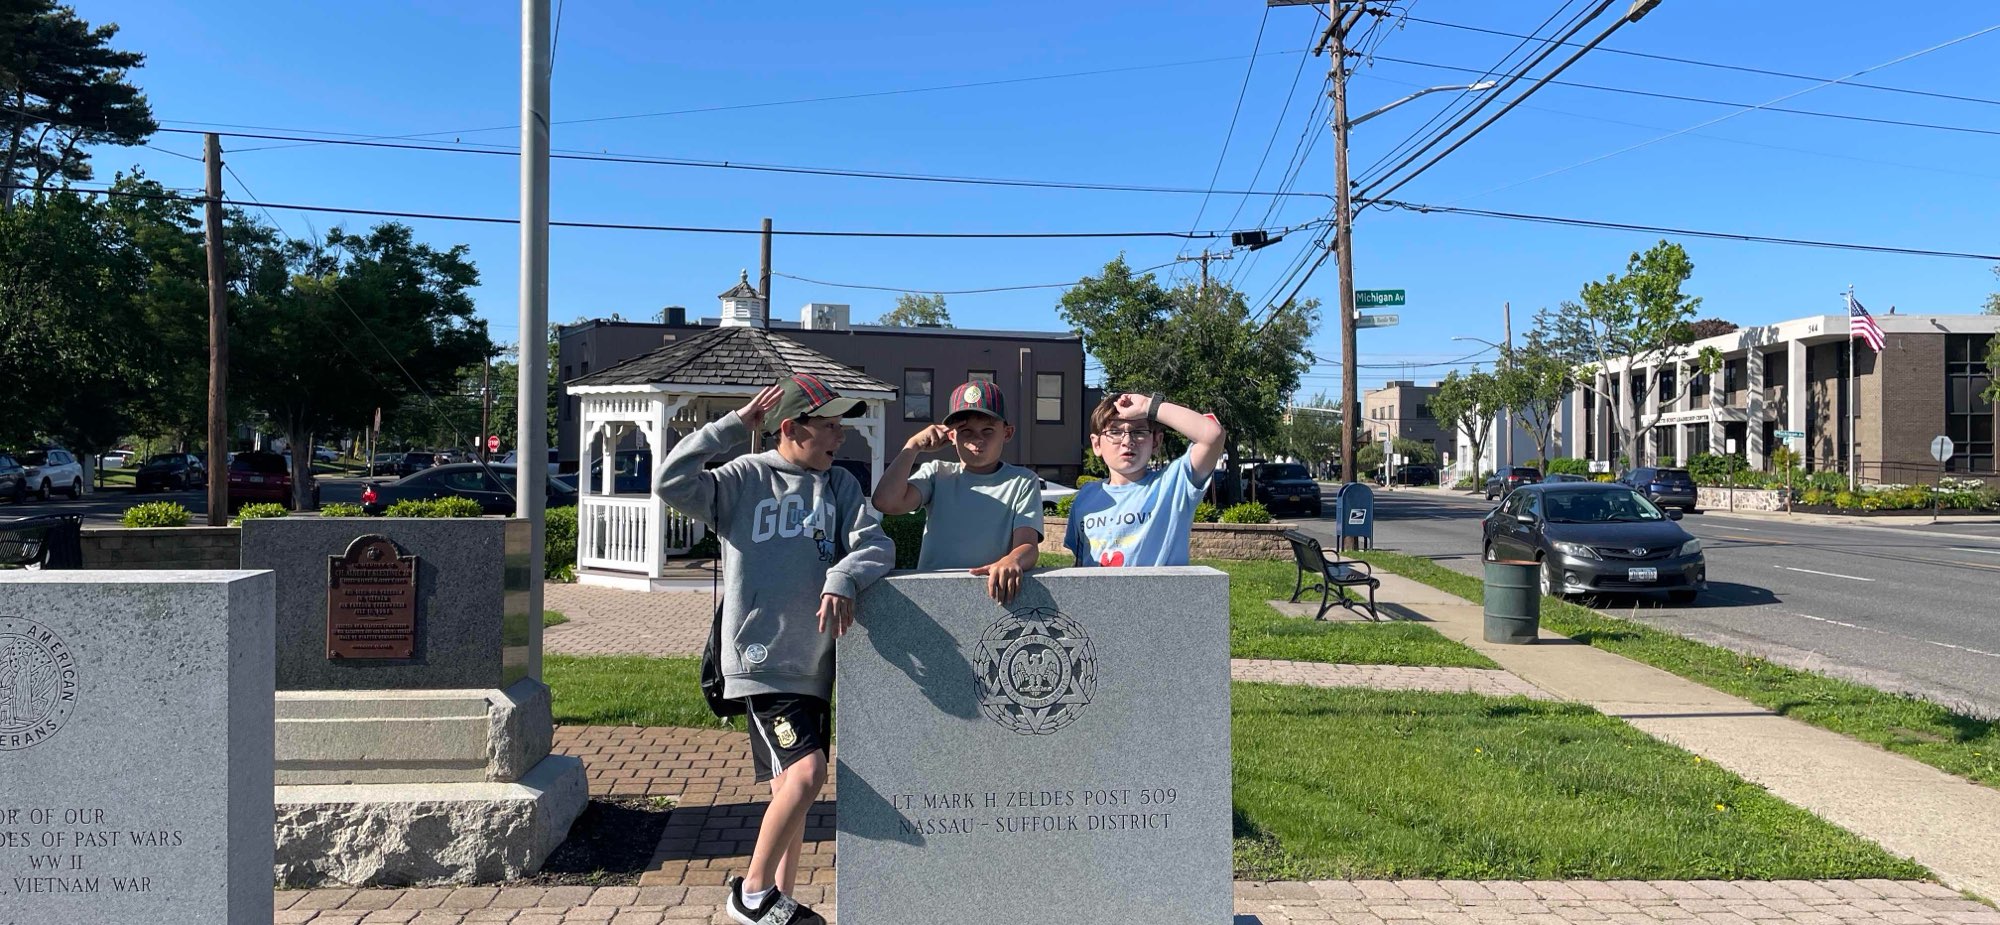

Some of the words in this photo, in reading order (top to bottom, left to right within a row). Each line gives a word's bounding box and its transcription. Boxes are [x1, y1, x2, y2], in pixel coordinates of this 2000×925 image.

[1356, 292, 1393, 304] Michigan
[1395, 293, 1404, 301] Av
[1023, 636, 1039, 644] WAR
[27, 625, 75, 701] AMERICAN
[0, 720, 57, 747] ERANS
[893, 794, 914, 810] LT
[924, 793, 974, 809] MARK
[985, 792, 996, 807] H
[1006, 790, 1075, 808] ZELDES
[1085, 789, 1131, 806] POST
[1140, 788, 1177, 805] 509
[30, 808, 54, 825] OF
[64, 808, 105, 824] OUR
[900, 818, 974, 834] NASSAU
[996, 815, 1078, 832] SUFFOLK
[1088, 813, 1171, 830] DISTRICT
[41, 831, 65, 848] OF
[75, 831, 121, 847] PAST
[130, 830, 183, 847] WARS
[29, 855, 63, 870] WW
[70, 854, 83, 870] II
[13, 877, 99, 893] VIETNAM
[113, 876, 152, 892] WAR
